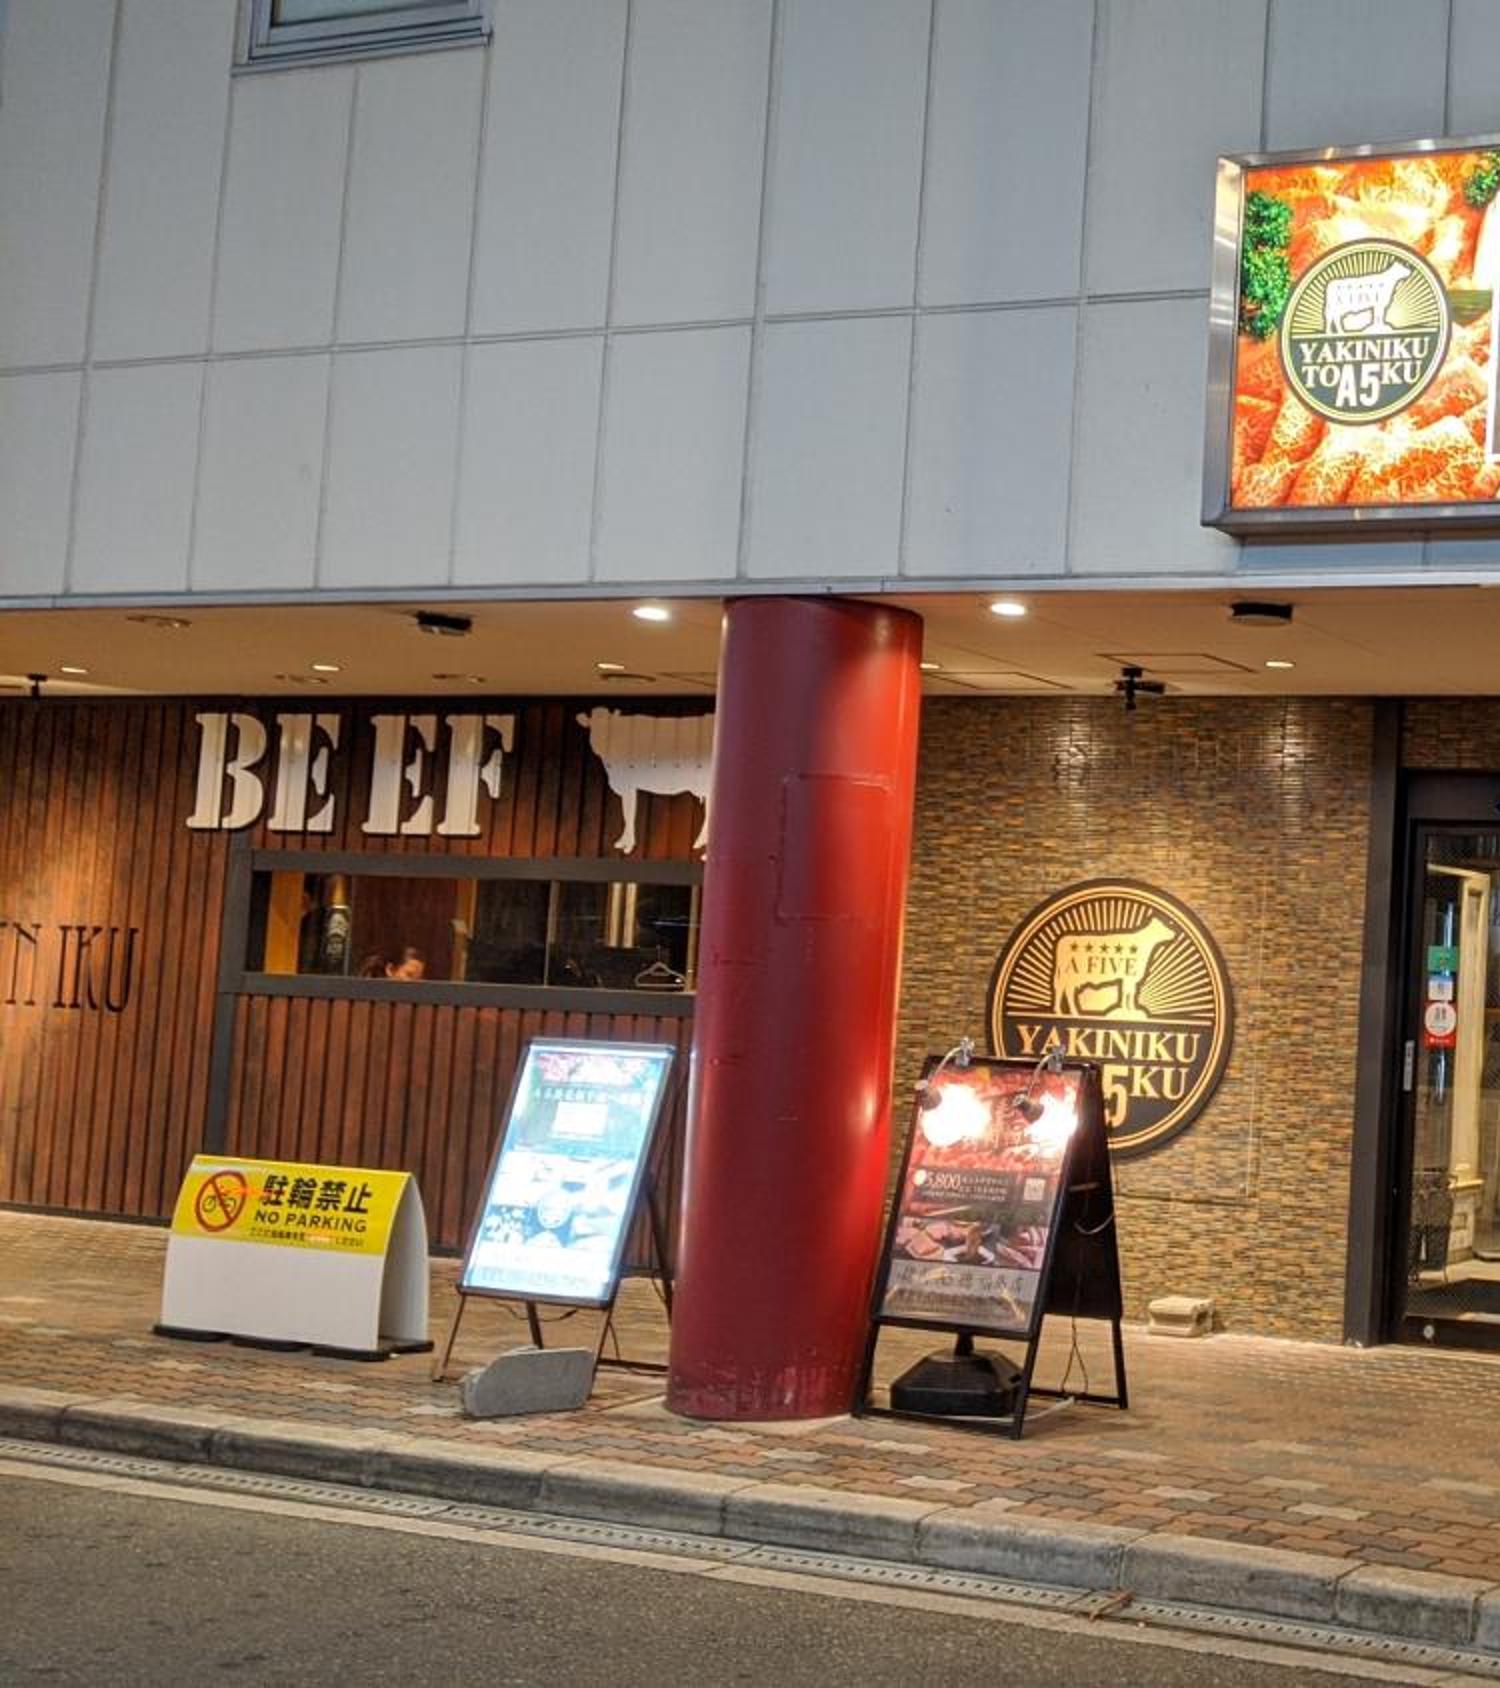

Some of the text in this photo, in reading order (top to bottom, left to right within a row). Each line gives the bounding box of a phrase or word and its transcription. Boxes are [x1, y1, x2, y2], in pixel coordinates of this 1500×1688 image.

[1300, 336, 1430, 366] YAKINIKU
[186, 712, 516, 837] BEEF
[0, 921, 139, 1013] NIKU
[1065, 956, 1138, 977] A FIVE
[1016, 1023, 1201, 1063] YAKINIKU
[261, 1173, 373, 1214] 駐輪禁止
[255, 1209, 367, 1233] NO PARKING
